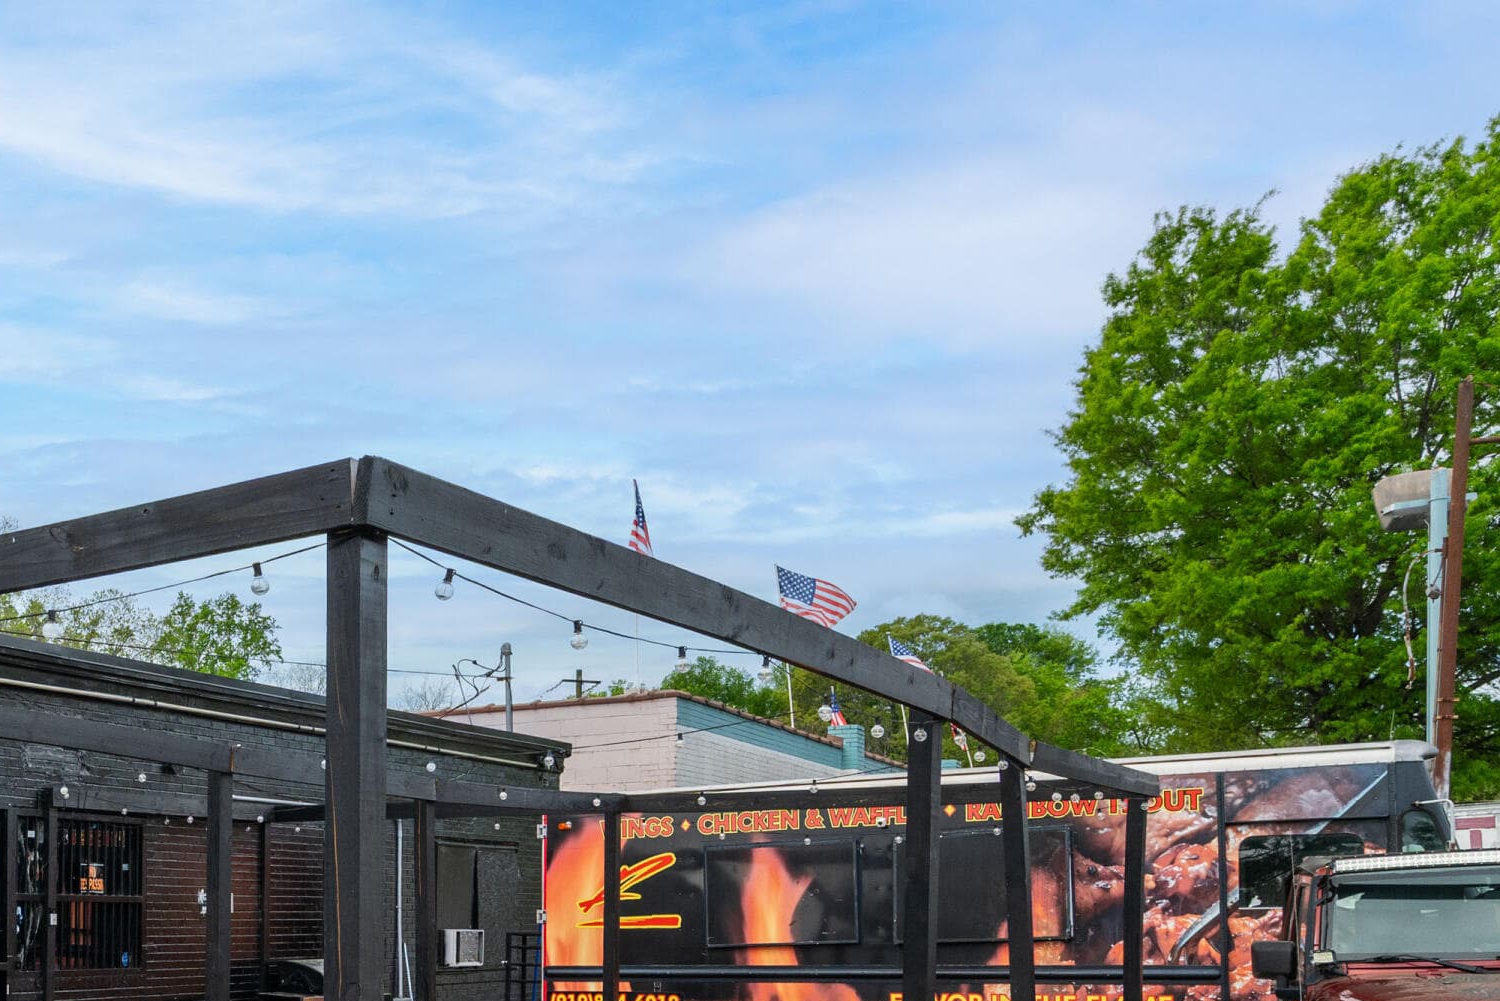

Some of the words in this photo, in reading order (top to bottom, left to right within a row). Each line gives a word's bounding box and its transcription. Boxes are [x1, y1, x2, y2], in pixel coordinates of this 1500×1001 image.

[600, 815, 674, 840] INGS
[697, 809, 799, 835] CHICKEN
[805, 808, 826, 829] &
[828, 804, 907, 828] WAFFL
[965, 799, 1099, 822] RABOW
